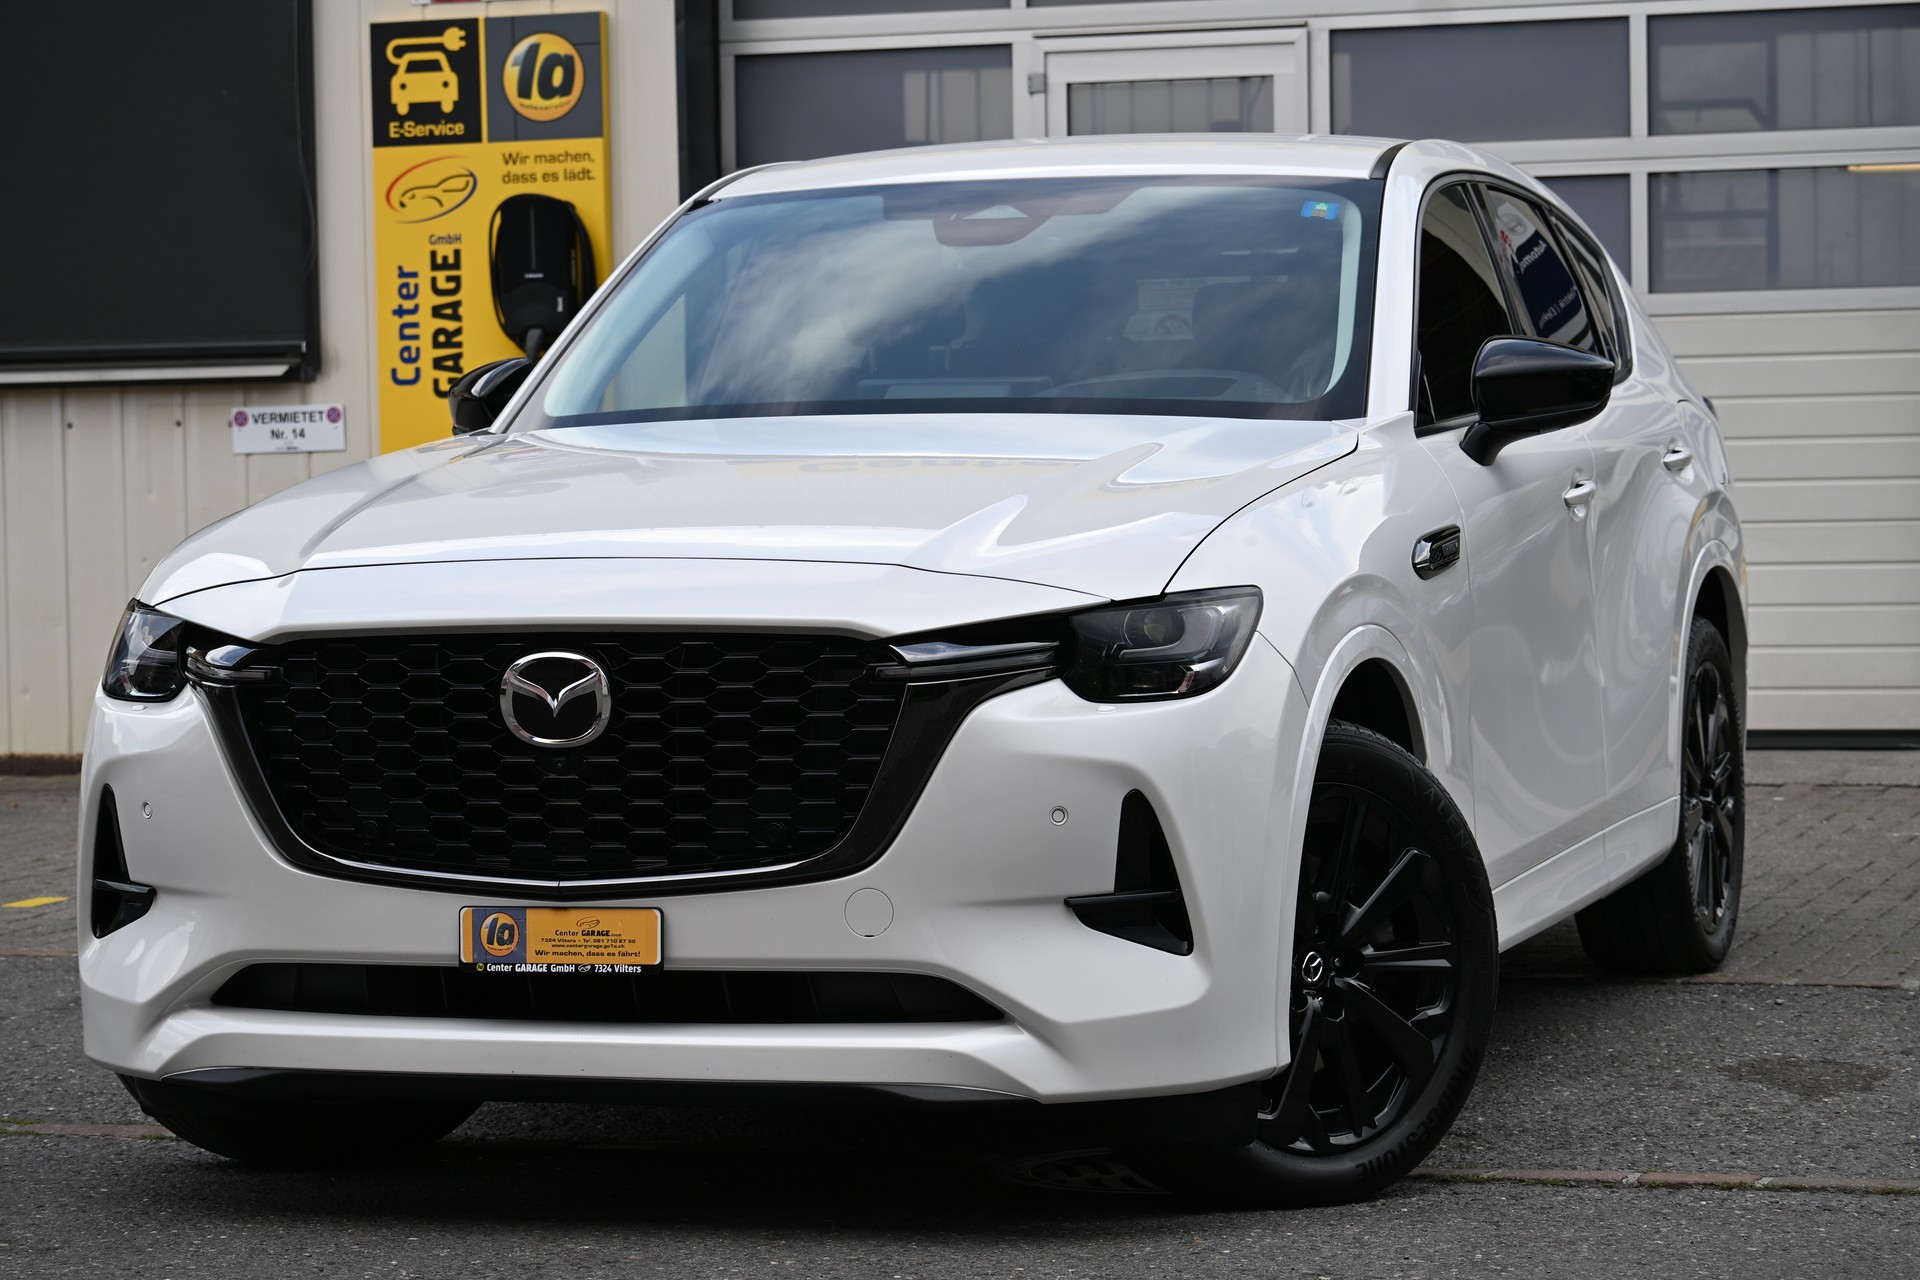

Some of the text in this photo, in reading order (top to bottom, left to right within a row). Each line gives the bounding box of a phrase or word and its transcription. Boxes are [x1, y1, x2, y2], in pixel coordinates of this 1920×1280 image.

[511, 41, 576, 101] 1a
[388, 119, 465, 138] E-Service
[502, 150, 595, 166] Wir machen,
[502, 167, 597, 185] dass es lädt.
[429, 234, 462, 246] GmbH
[391, 265, 421, 386] Center
[252, 410, 325, 425] VERMIETET
[270, 428, 306, 440] Nr. 14
[484, 916, 515, 946] 1a
[555, 929, 579, 937] Center
[581, 929, 611, 937] GARAGE
[618, 950, 641, 958] fährt!
[486, 963, 513, 972] Center
[515, 964, 548, 972] GARAGE
[550, 964, 576, 973] GmbH
[594, 964, 612, 973] 7324
[614, 964, 642, 973] Vilters
